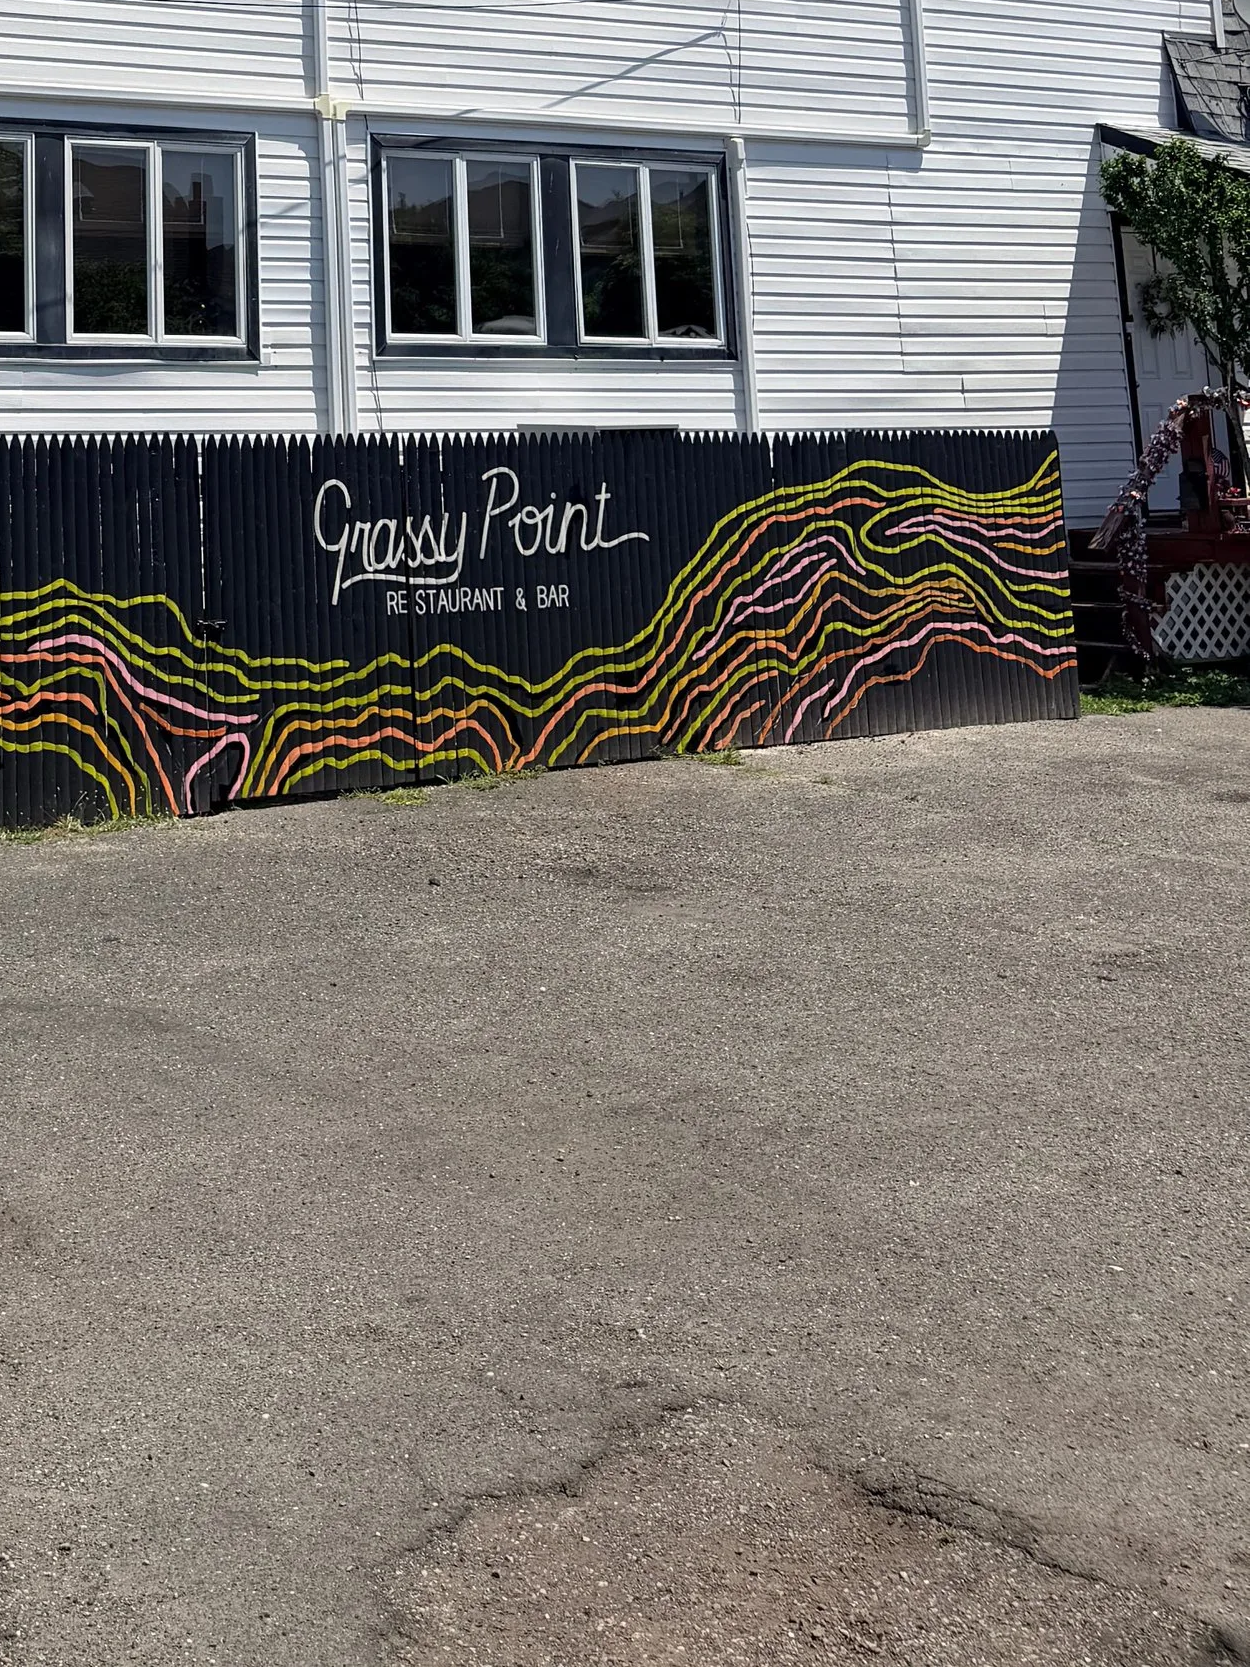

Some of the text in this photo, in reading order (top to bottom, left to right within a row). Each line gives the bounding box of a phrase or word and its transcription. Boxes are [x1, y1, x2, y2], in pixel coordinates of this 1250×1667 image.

[313, 466, 650, 606] Grassy Point
[515, 587, 528, 612] &
[536, 584, 571, 609] BAR
